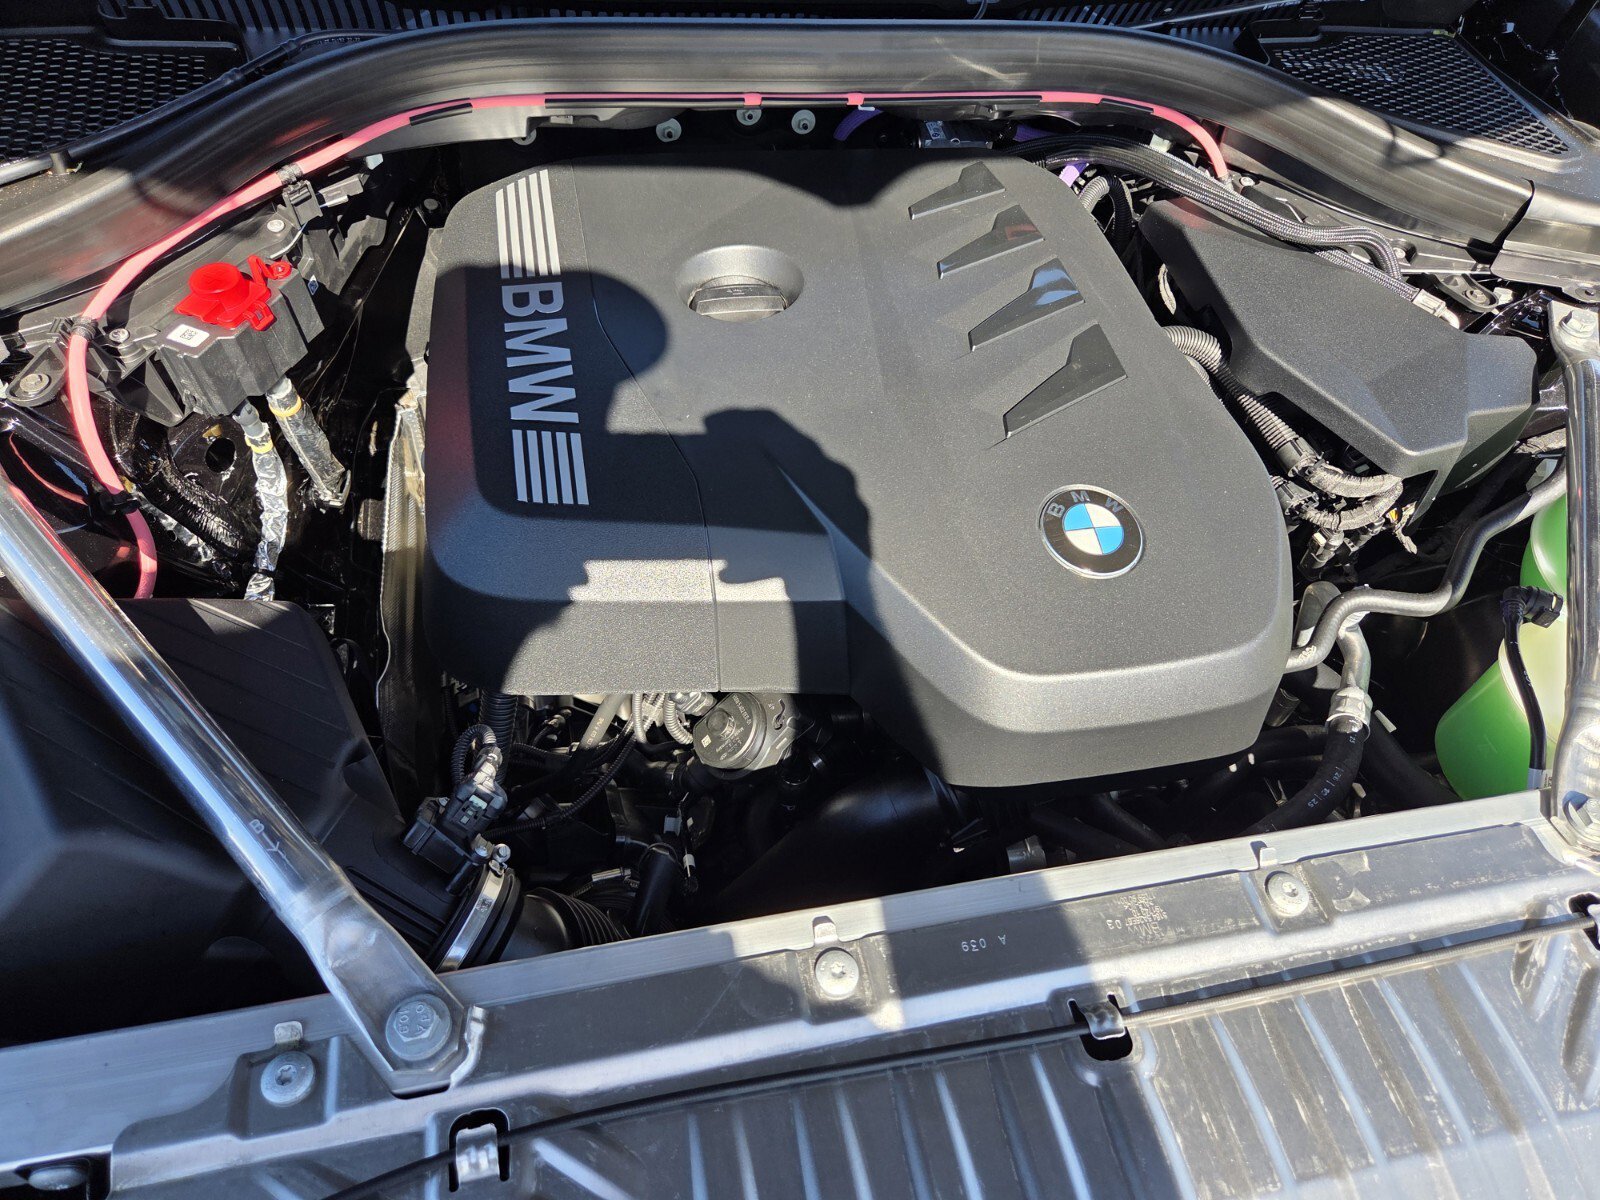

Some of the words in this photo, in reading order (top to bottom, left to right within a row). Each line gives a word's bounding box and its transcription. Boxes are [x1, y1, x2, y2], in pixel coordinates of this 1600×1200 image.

[502, 281, 579, 424] BMW
[1046, 490, 1125, 519] BMW
[961, 938, 987, 952] 039
[997, 934, 1007, 945] A
